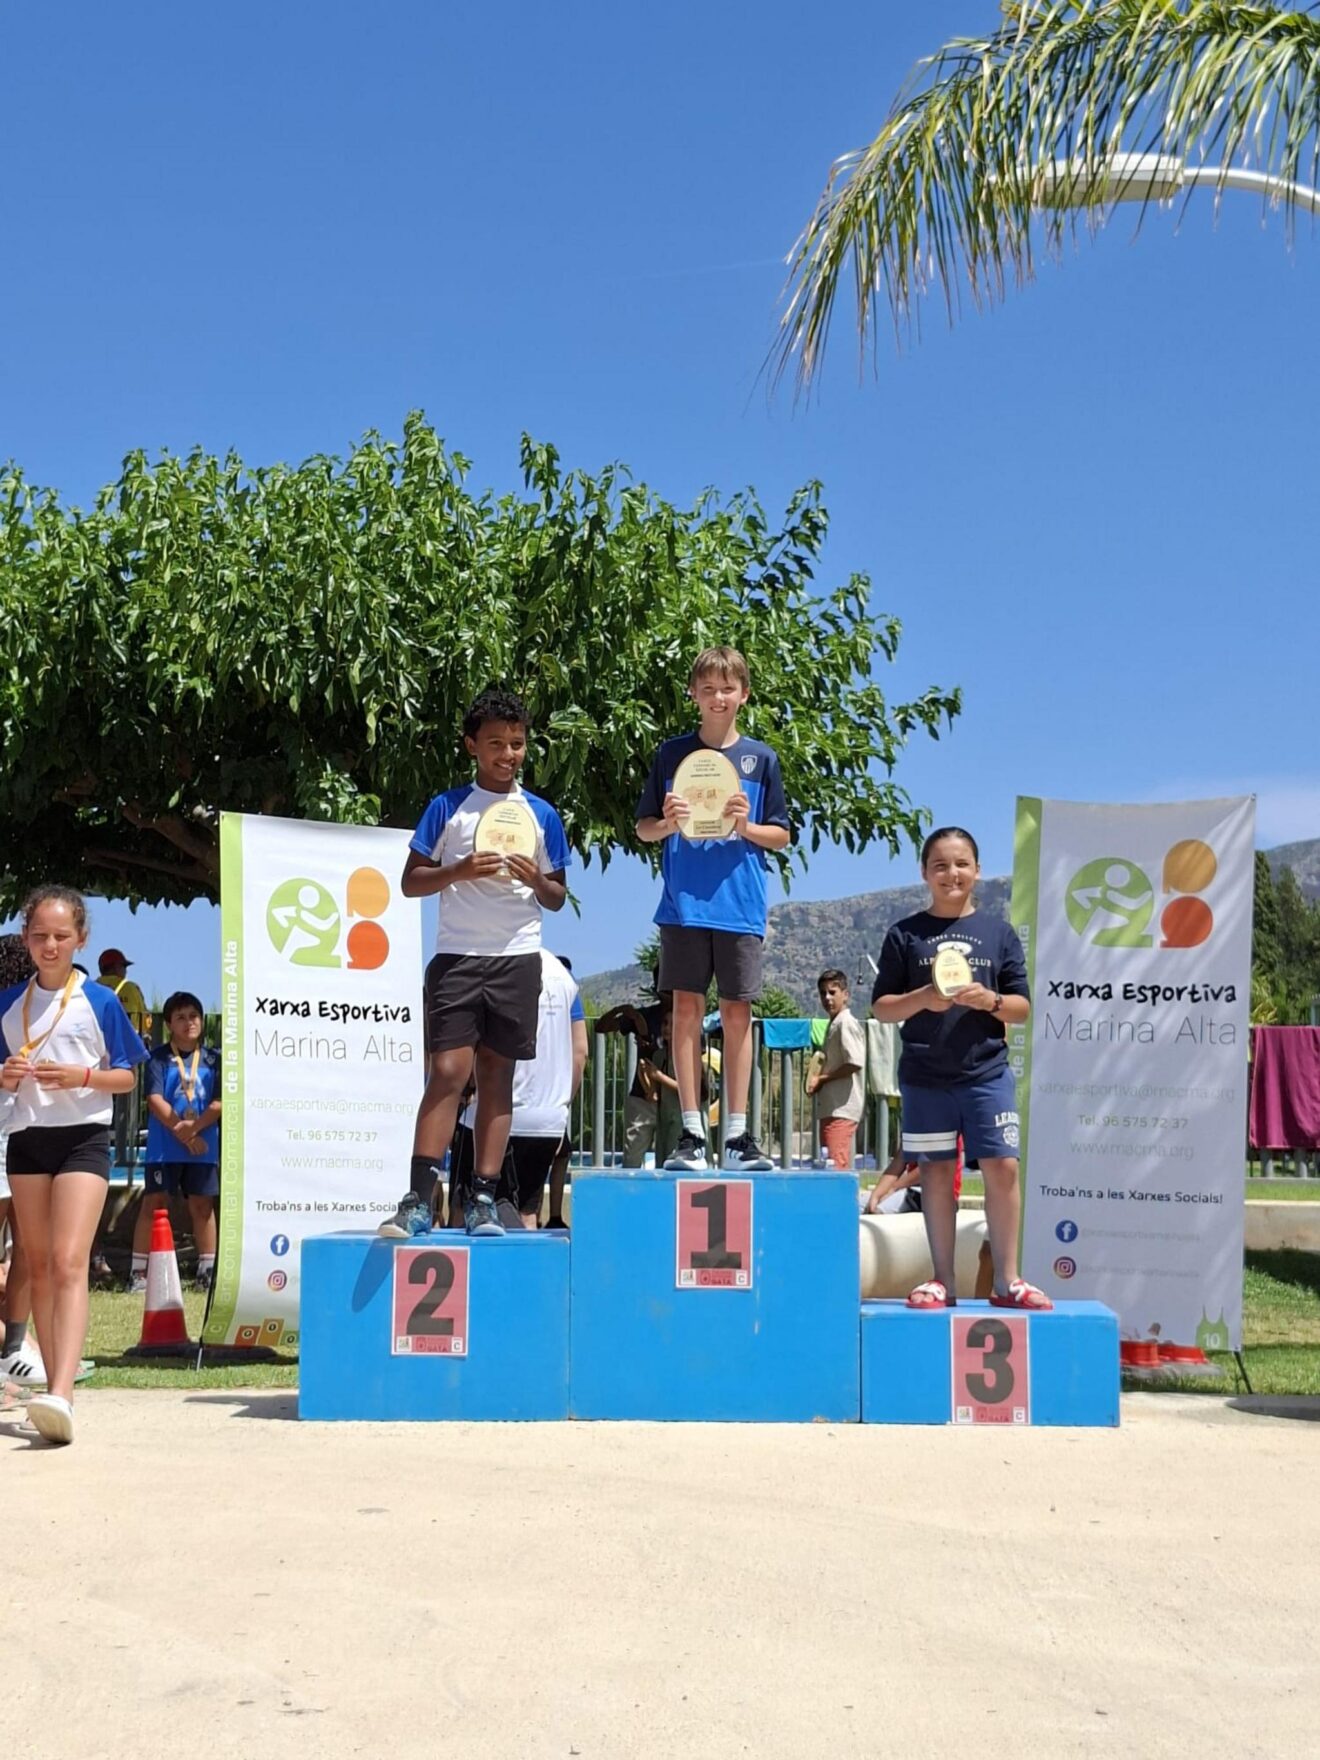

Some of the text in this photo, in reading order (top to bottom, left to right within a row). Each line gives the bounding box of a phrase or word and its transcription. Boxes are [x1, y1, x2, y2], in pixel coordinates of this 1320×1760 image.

[225, 940, 238, 977] Alta
[1122, 983, 1236, 1005] Esportiva
[225, 983, 238, 1044] Marina
[319, 1000, 411, 1024] Esportiva
[1044, 1013, 1154, 1043] Marina
[1174, 1015, 1236, 1045] Alta
[225, 1050, 238, 1065] la
[254, 1029, 413, 1063] Marina Alta
[225, 1070, 238, 1093] de
[1102, 1116, 1119, 1126] 96
[1122, 1116, 1147, 1127] 575
[1151, 1117, 1168, 1128] 72
[1172, 1118, 1189, 1129] 37
[223, 1098, 238, 1184] Comarcal
[287, 1129, 378, 1143] Tel. 96 575 72 37
[281, 1156, 383, 1173] www.macma.org
[256, 1200, 399, 1212] Troba'ns a les Xarxes Socia
[1040, 1185, 1222, 1204] Troba'ns a les Xarxes Socials!
[691, 1184, 742, 1269] 1
[406, 1251, 455, 1335] 2
[1202, 1332, 1221, 1348] 10
[965, 1317, 1015, 1404] 3
